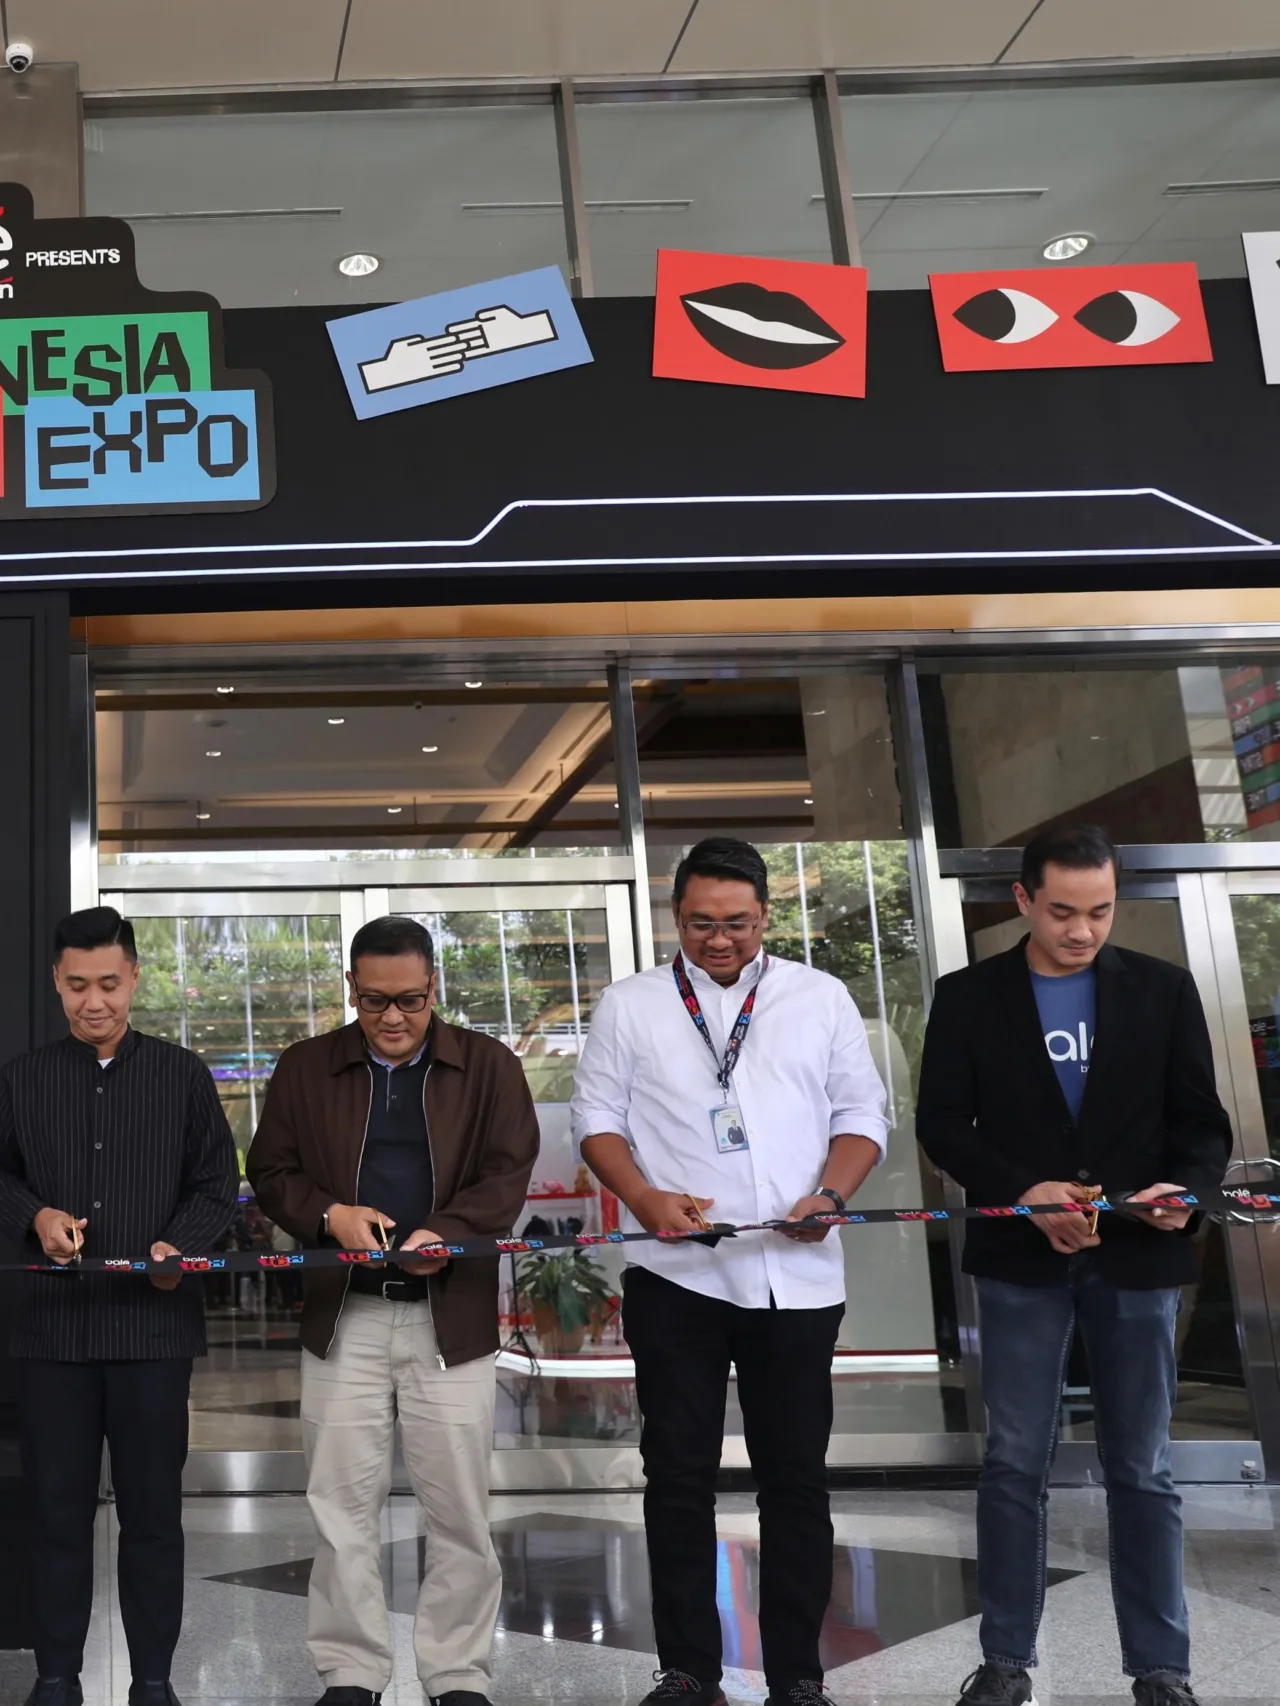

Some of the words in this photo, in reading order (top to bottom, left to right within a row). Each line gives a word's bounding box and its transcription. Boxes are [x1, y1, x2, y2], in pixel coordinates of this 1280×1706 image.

[25, 247, 121, 268] PRESENTS
[36, 398, 248, 490] EXPO
[1044, 1021, 1095, 1062] al
